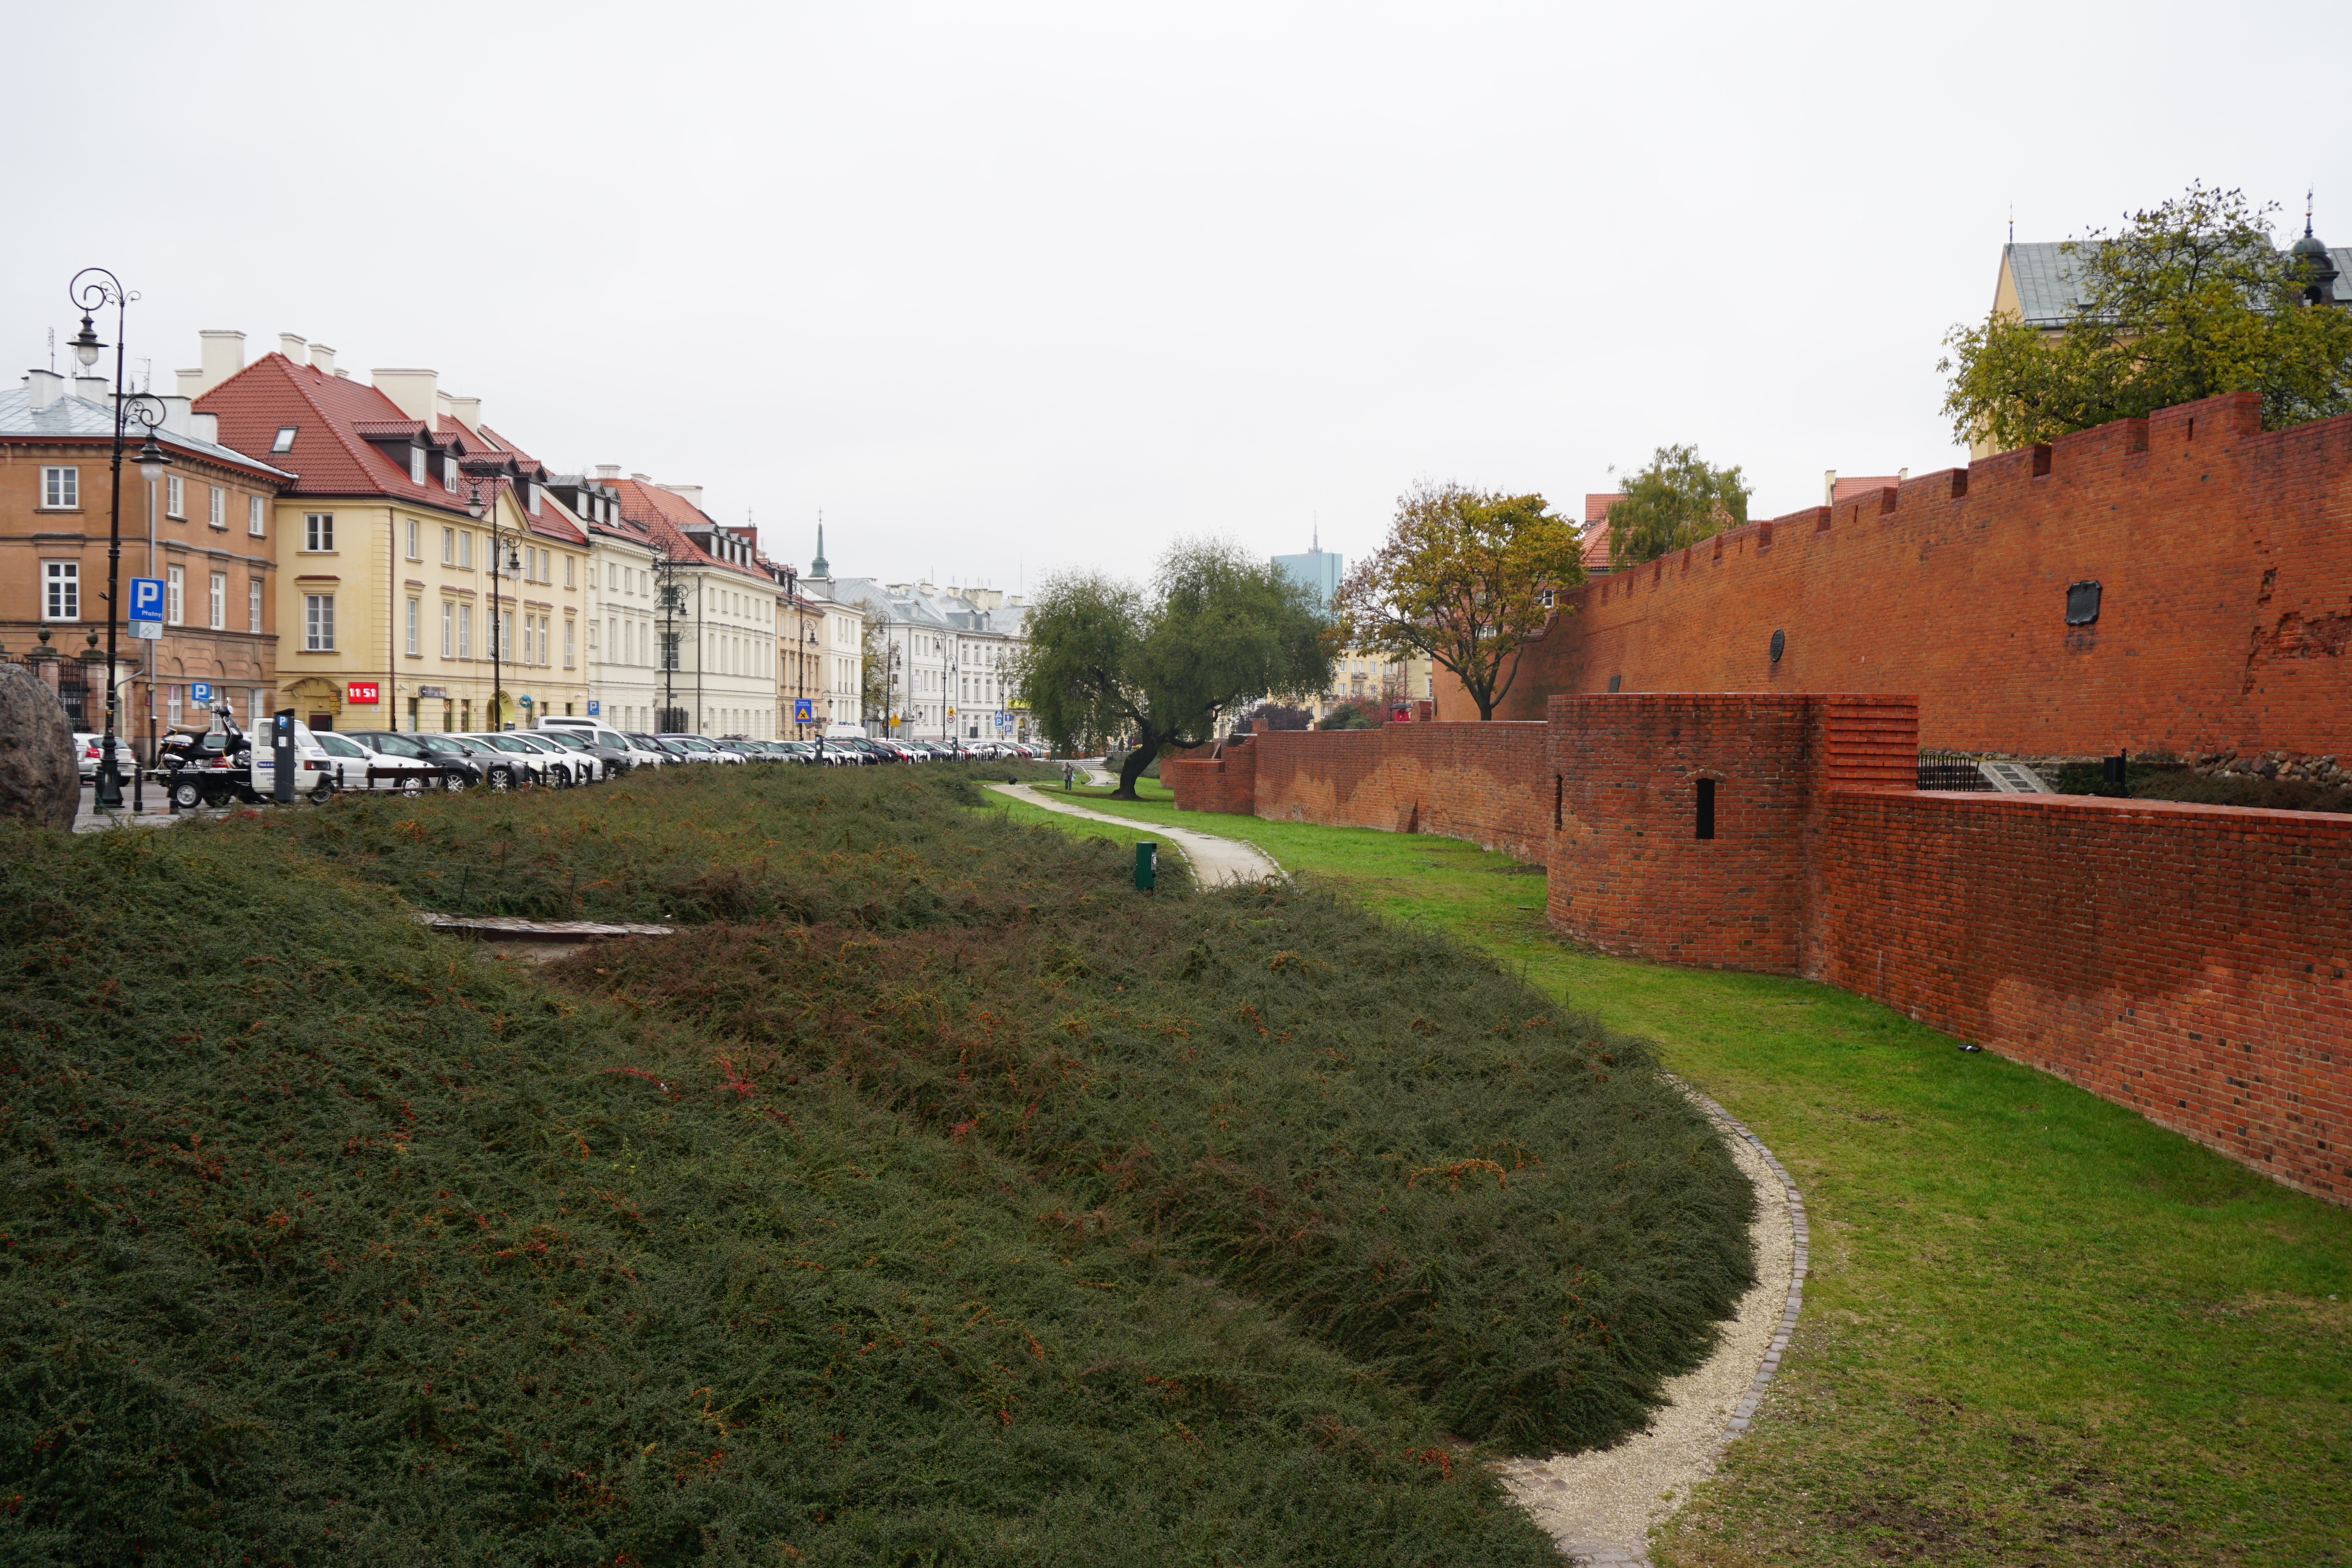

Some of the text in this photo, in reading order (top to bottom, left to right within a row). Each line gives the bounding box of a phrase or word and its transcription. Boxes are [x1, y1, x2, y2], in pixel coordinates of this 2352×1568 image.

[137, 581, 158, 608] P
[142, 610, 162, 618] Płatny
[195, 684, 206, 698] P
[349, 688, 376, 697] 11 51
[590, 702, 597, 711] P
[279, 716, 286, 726] P
